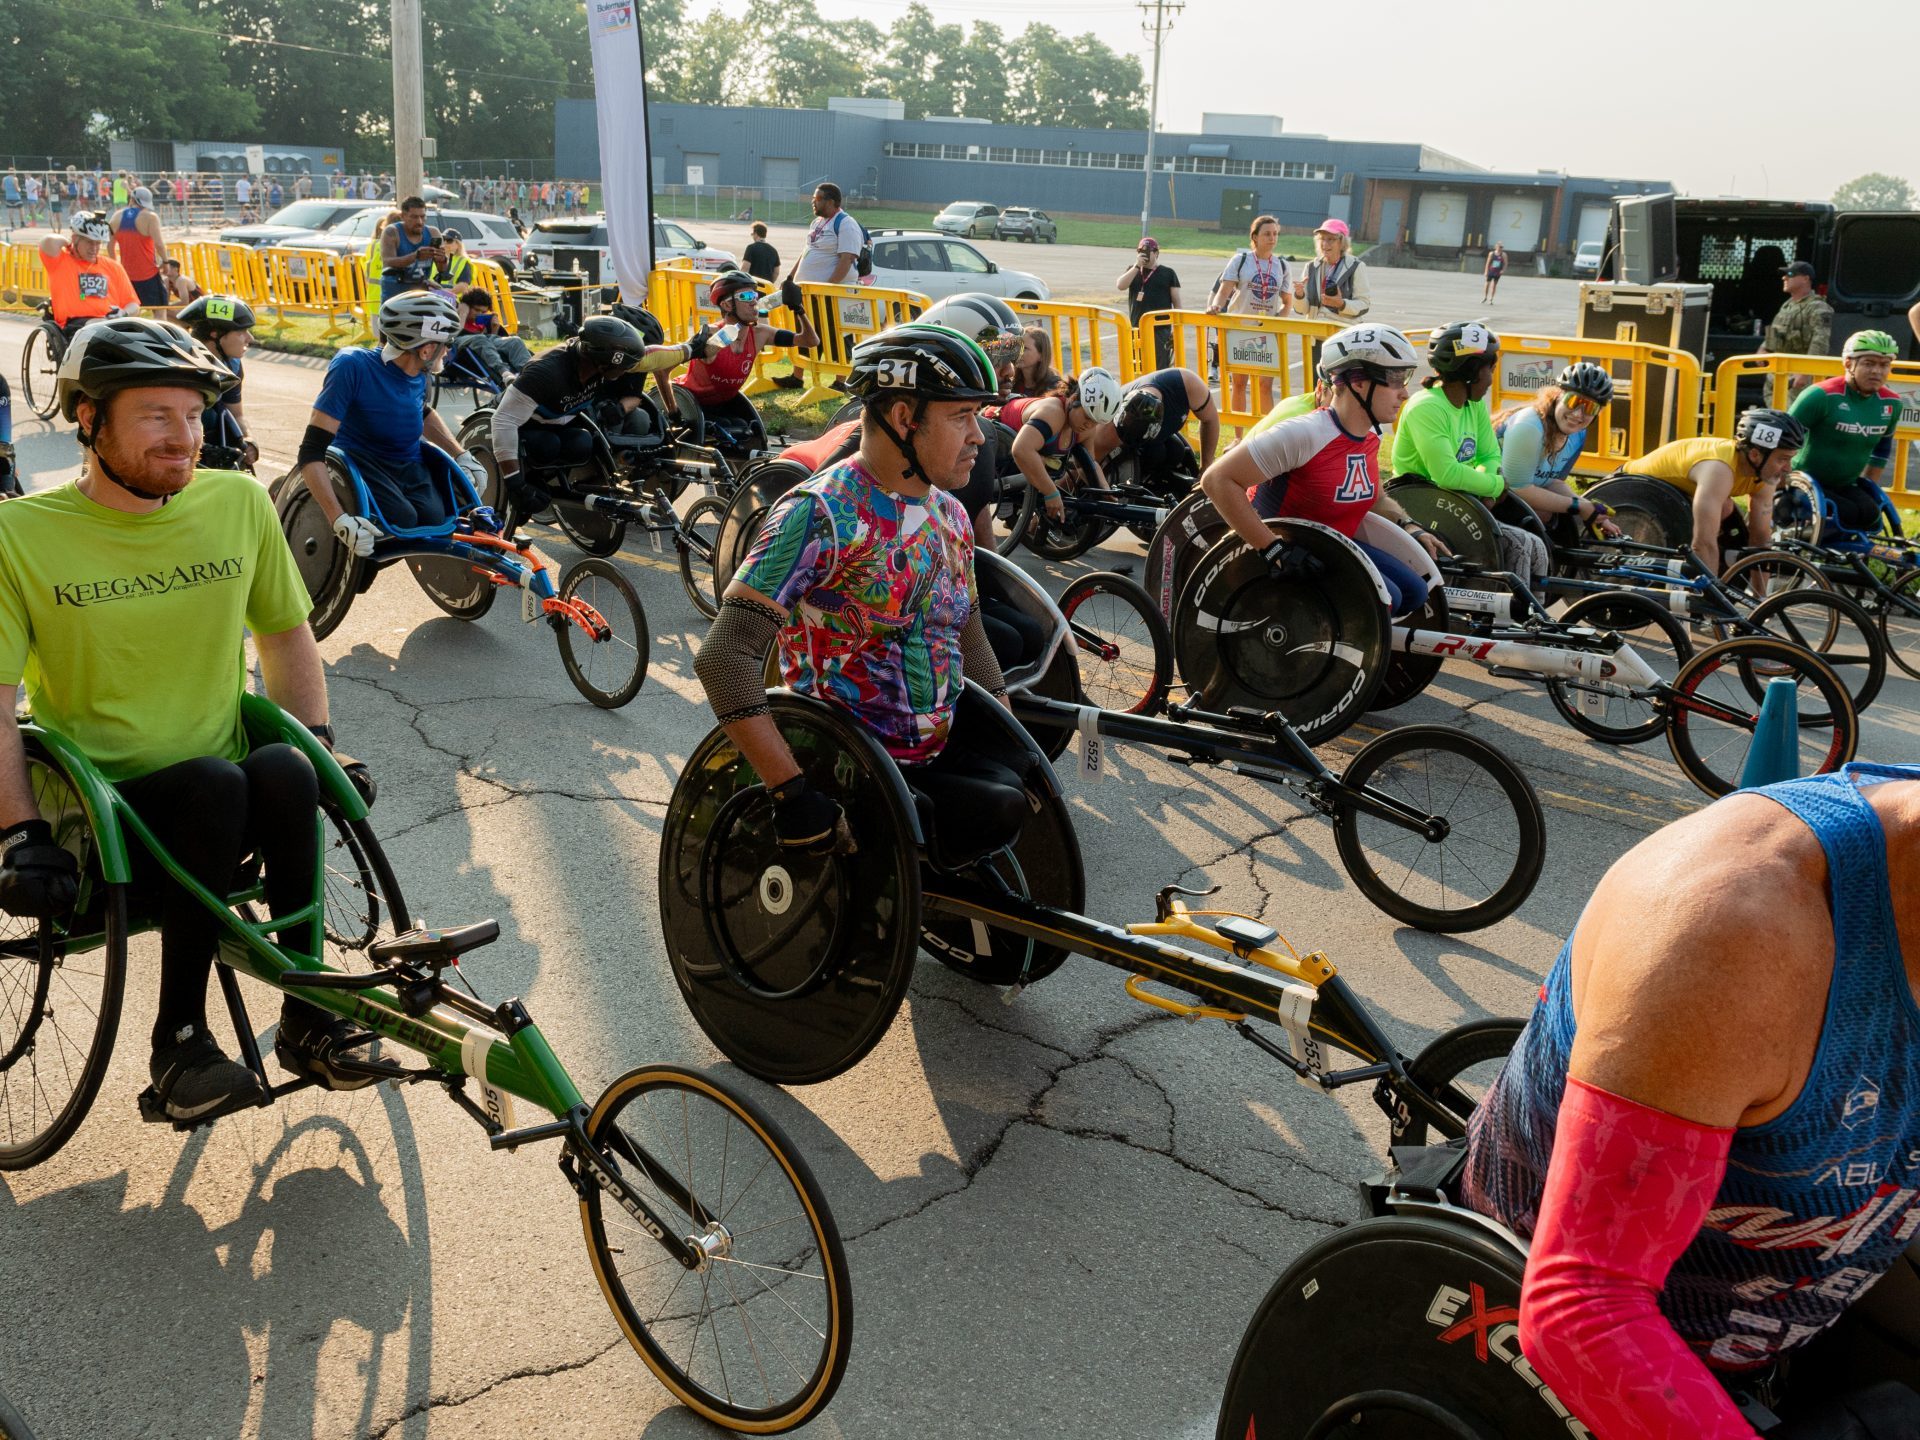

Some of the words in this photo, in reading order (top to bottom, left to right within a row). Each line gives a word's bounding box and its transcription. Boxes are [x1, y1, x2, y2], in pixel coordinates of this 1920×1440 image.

[1510, 210, 1523, 230] 2
[80, 276, 107, 291] 5527
[210, 303, 230, 316] 14
[430, 320, 442, 335] 4
[1351, 329, 1376, 344] 13
[1470, 330, 1480, 343] 3
[1233, 346, 1278, 364] Boilermaker
[711, 374, 745, 385] MATR
[878, 359, 918, 388] 31
[1508, 371, 1557, 390] Boilermake
[1084, 387, 1096, 404] 25
[1755, 428, 1776, 444] 18
[1334, 454, 1375, 503] A
[1435, 498, 1483, 542] EXCEED
[1193, 543, 1254, 608] CORIM
[1161, 587, 1172, 622] AGILE
[1443, 588, 1495, 600] ONTGOMER
[527, 594, 535, 618] 5504
[1291, 667, 1367, 734] CORIM
[1587, 679, 1600, 705] 513
[1087, 738, 1099, 772] 5522
[353, 999, 400, 1032] TOP
[396, 1021, 447, 1053] END
[487, 1088, 500, 1126] 505
[585, 1160, 624, 1198] TOP
[620, 1194, 665, 1241] END
